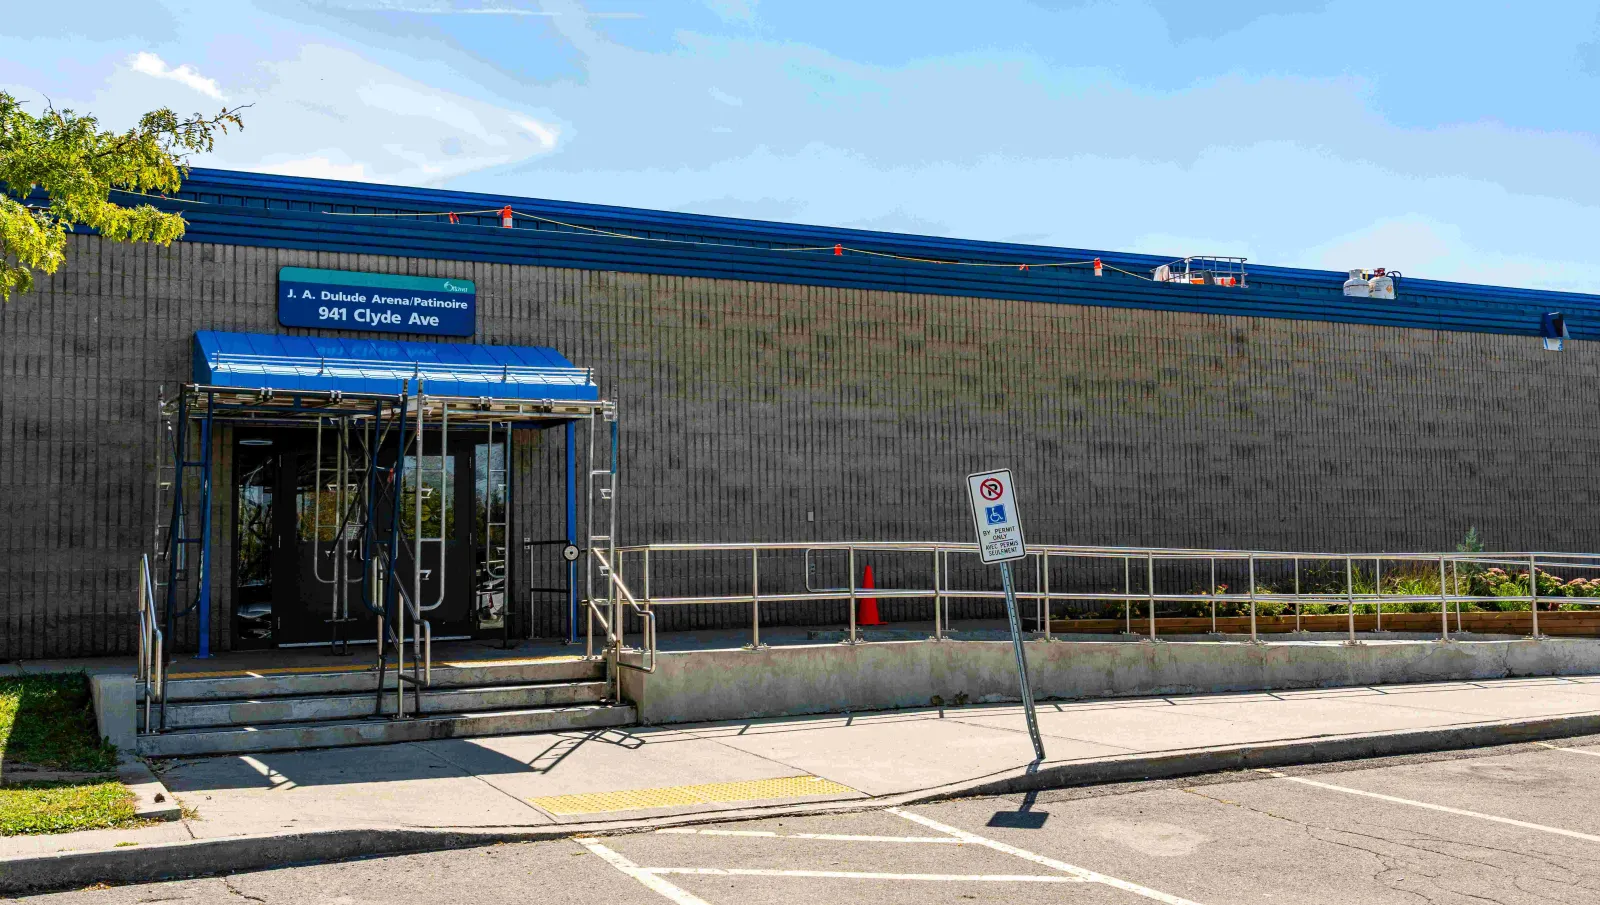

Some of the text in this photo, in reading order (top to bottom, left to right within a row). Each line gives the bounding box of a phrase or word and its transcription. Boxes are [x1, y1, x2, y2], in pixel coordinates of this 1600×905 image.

[287, 289, 468, 309] J. A. Dulude Arena/Patinoire
[318, 306, 439, 326] 941 Clyde Ave
[994, 526, 1015, 534] PERMIT
[1000, 540, 1019, 548] PERMIS
[988, 547, 1017, 556] SEULEMENT
